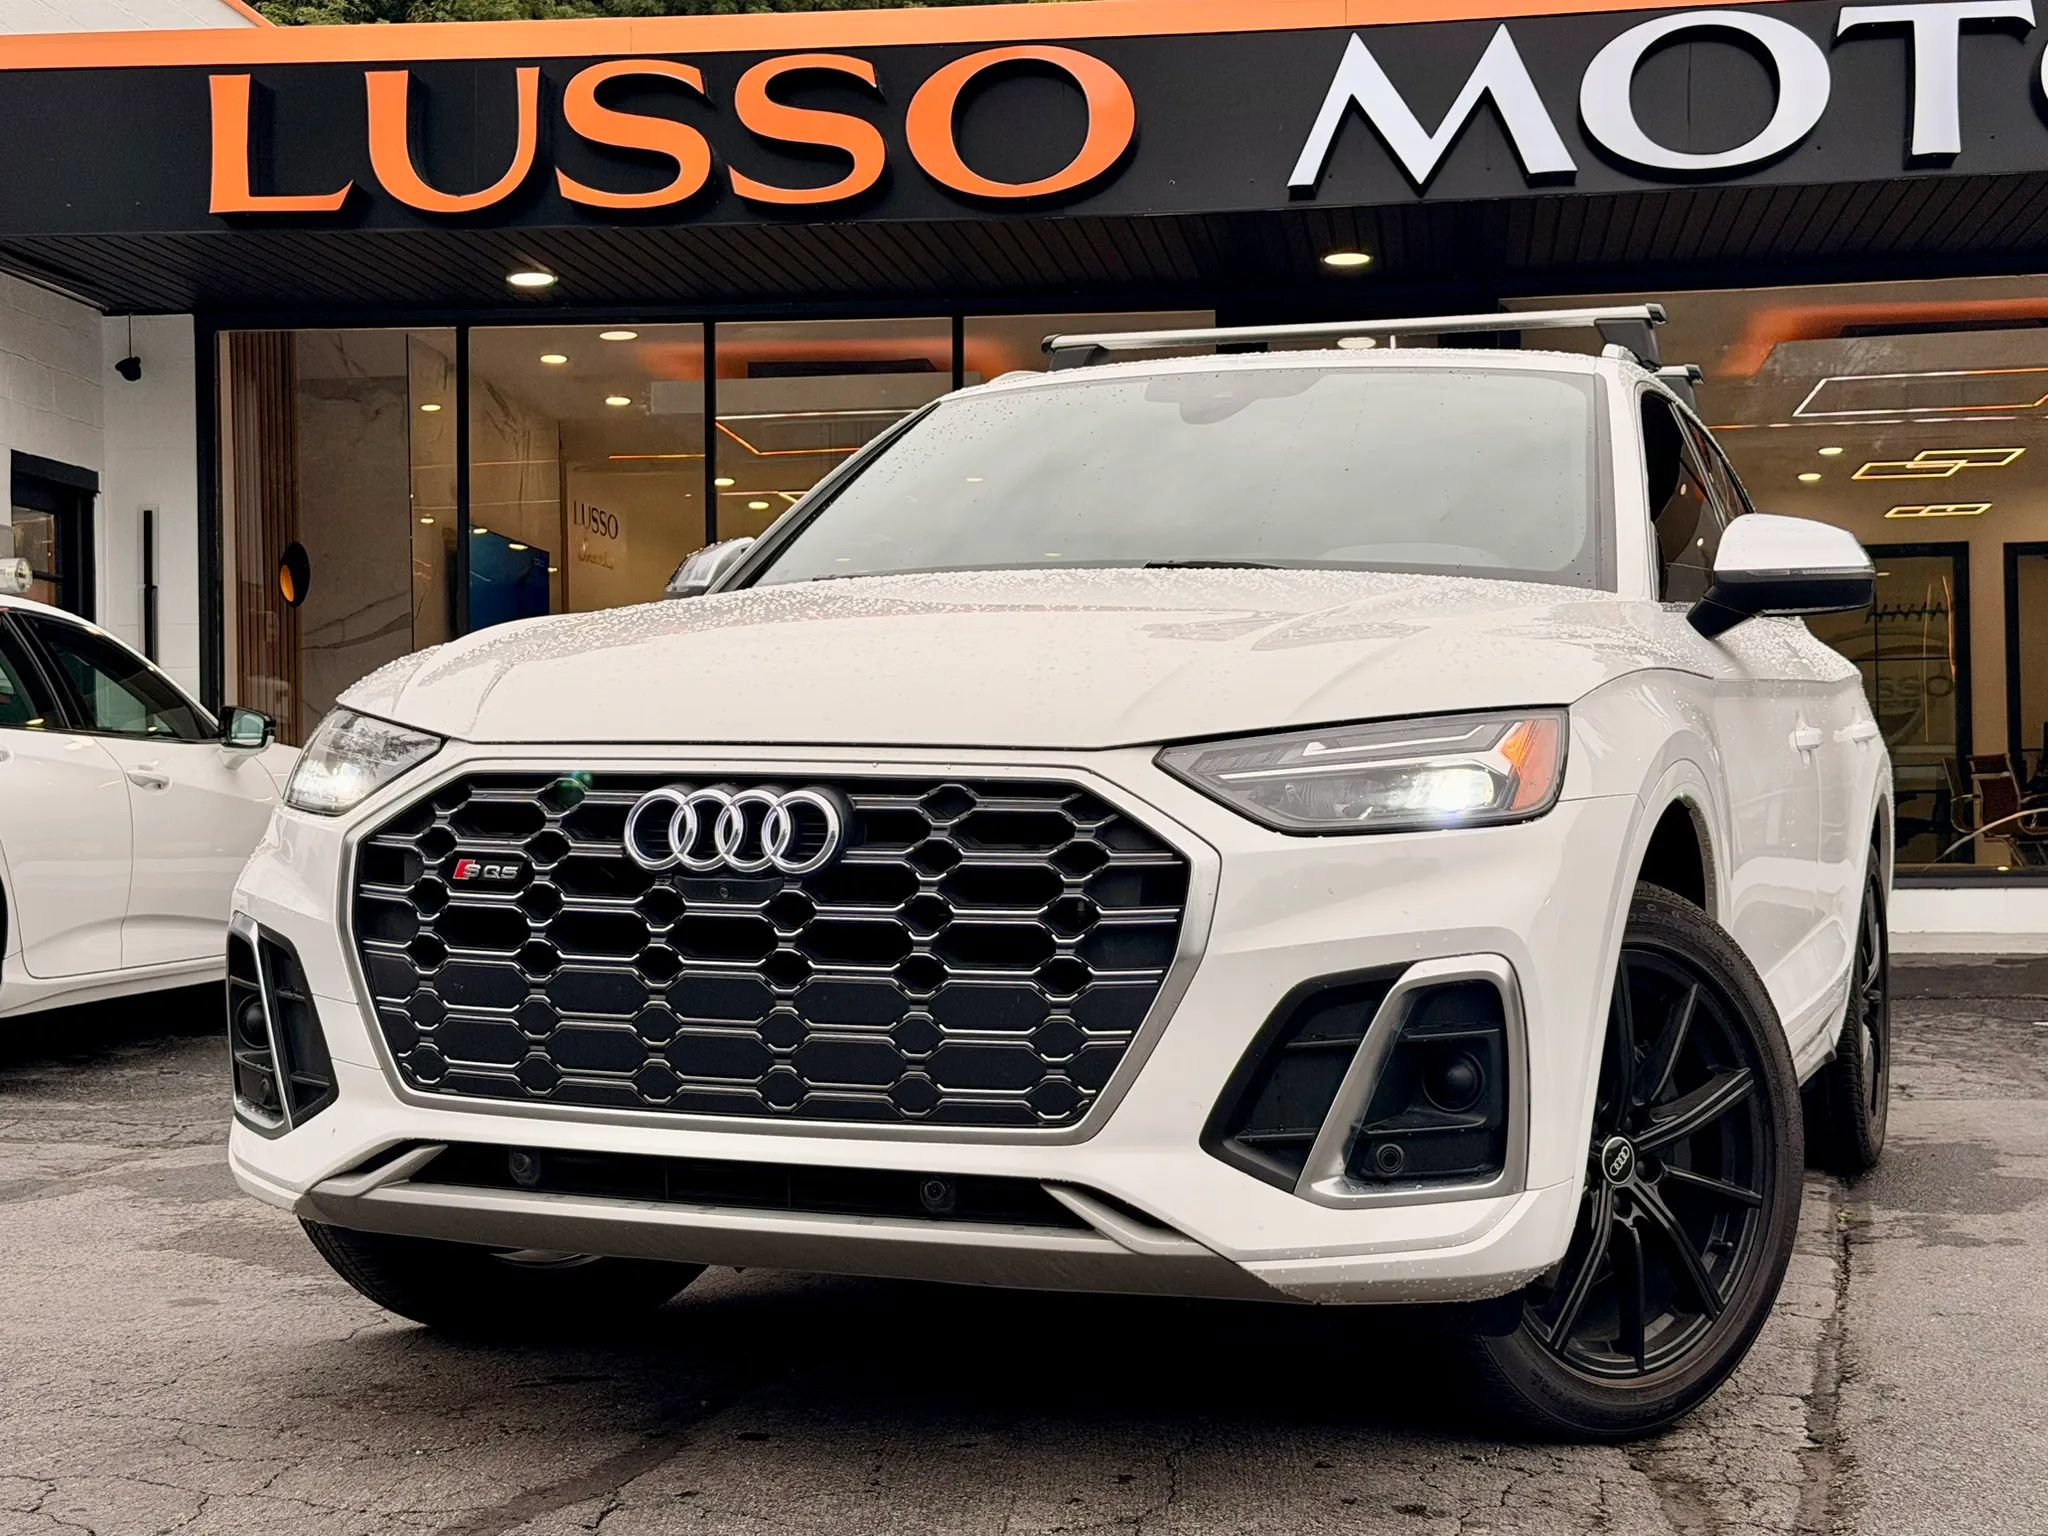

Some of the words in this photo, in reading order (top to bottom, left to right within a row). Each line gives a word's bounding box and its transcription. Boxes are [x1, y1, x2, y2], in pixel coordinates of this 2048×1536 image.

[208, 45, 1136, 214] LUSSO
[1287, 0, 2048, 188] MOT
[573, 500, 619, 540] LUSSO
